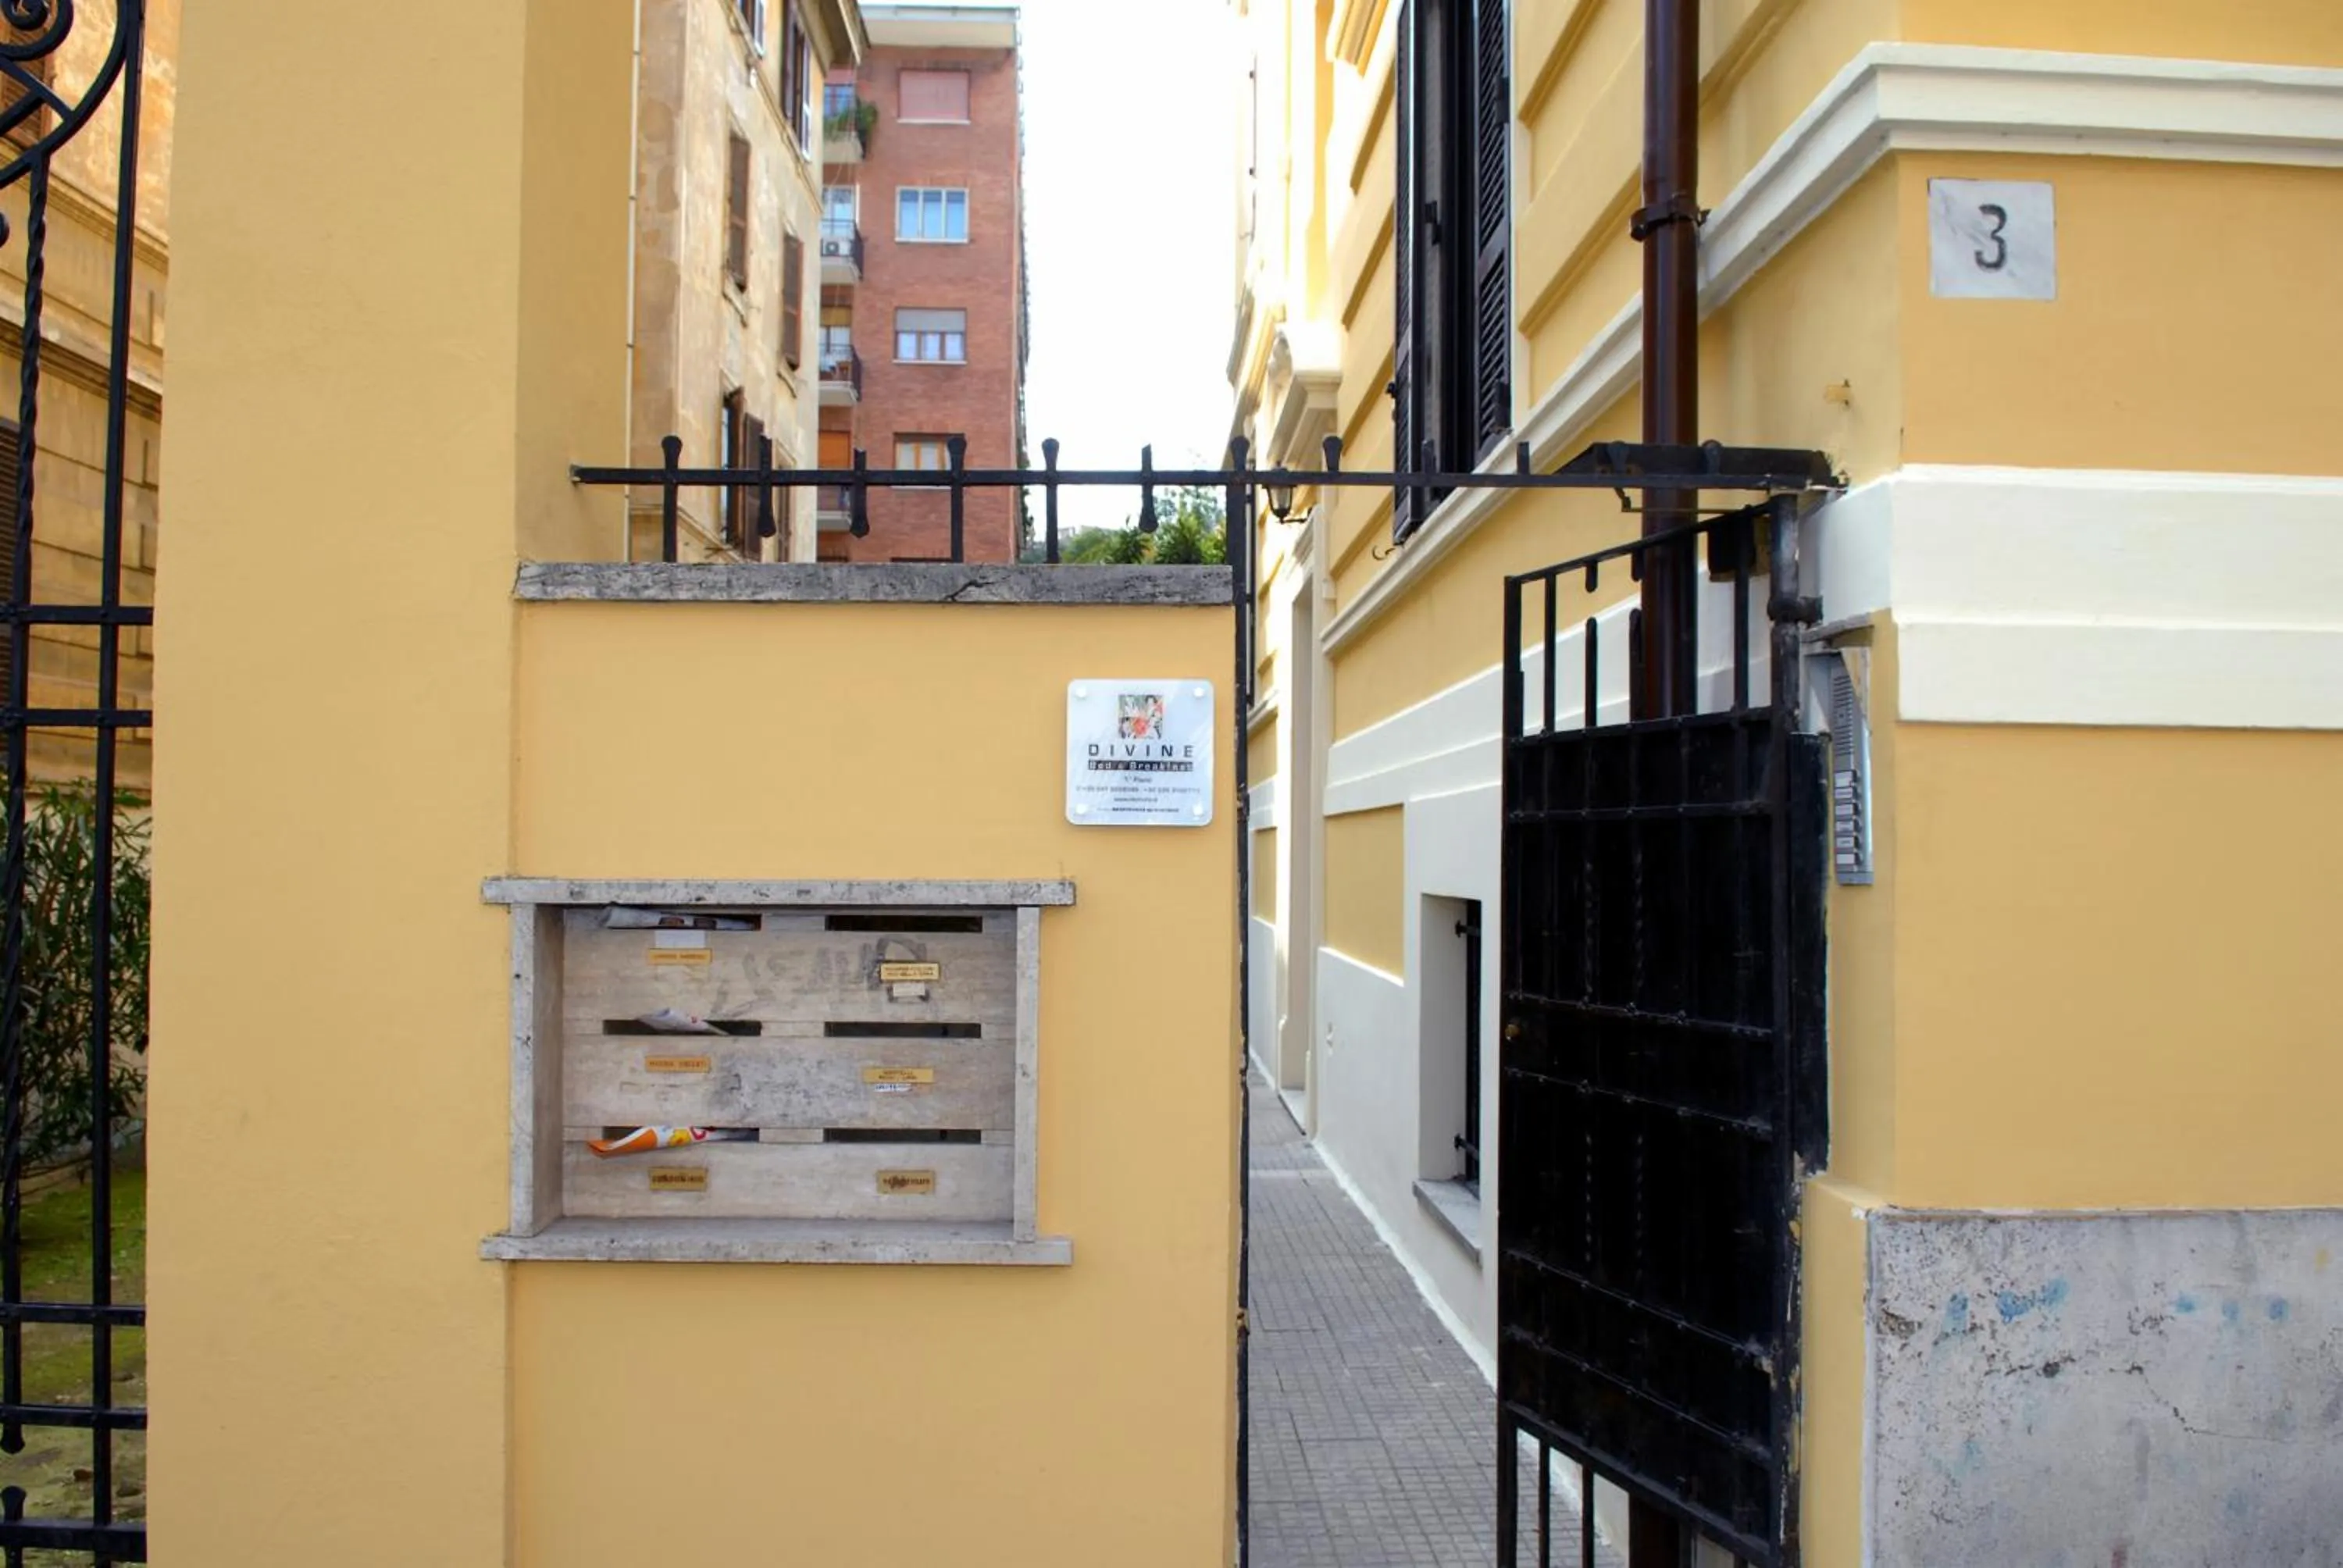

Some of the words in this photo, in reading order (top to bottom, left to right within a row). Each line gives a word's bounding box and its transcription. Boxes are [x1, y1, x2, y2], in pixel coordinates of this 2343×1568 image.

[1974, 203, 2007, 272] 3
[1088, 743, 1194, 757] DIVINE
[1089, 760, 1112, 770] Bed
[1129, 761, 1193, 772] Breakfast
